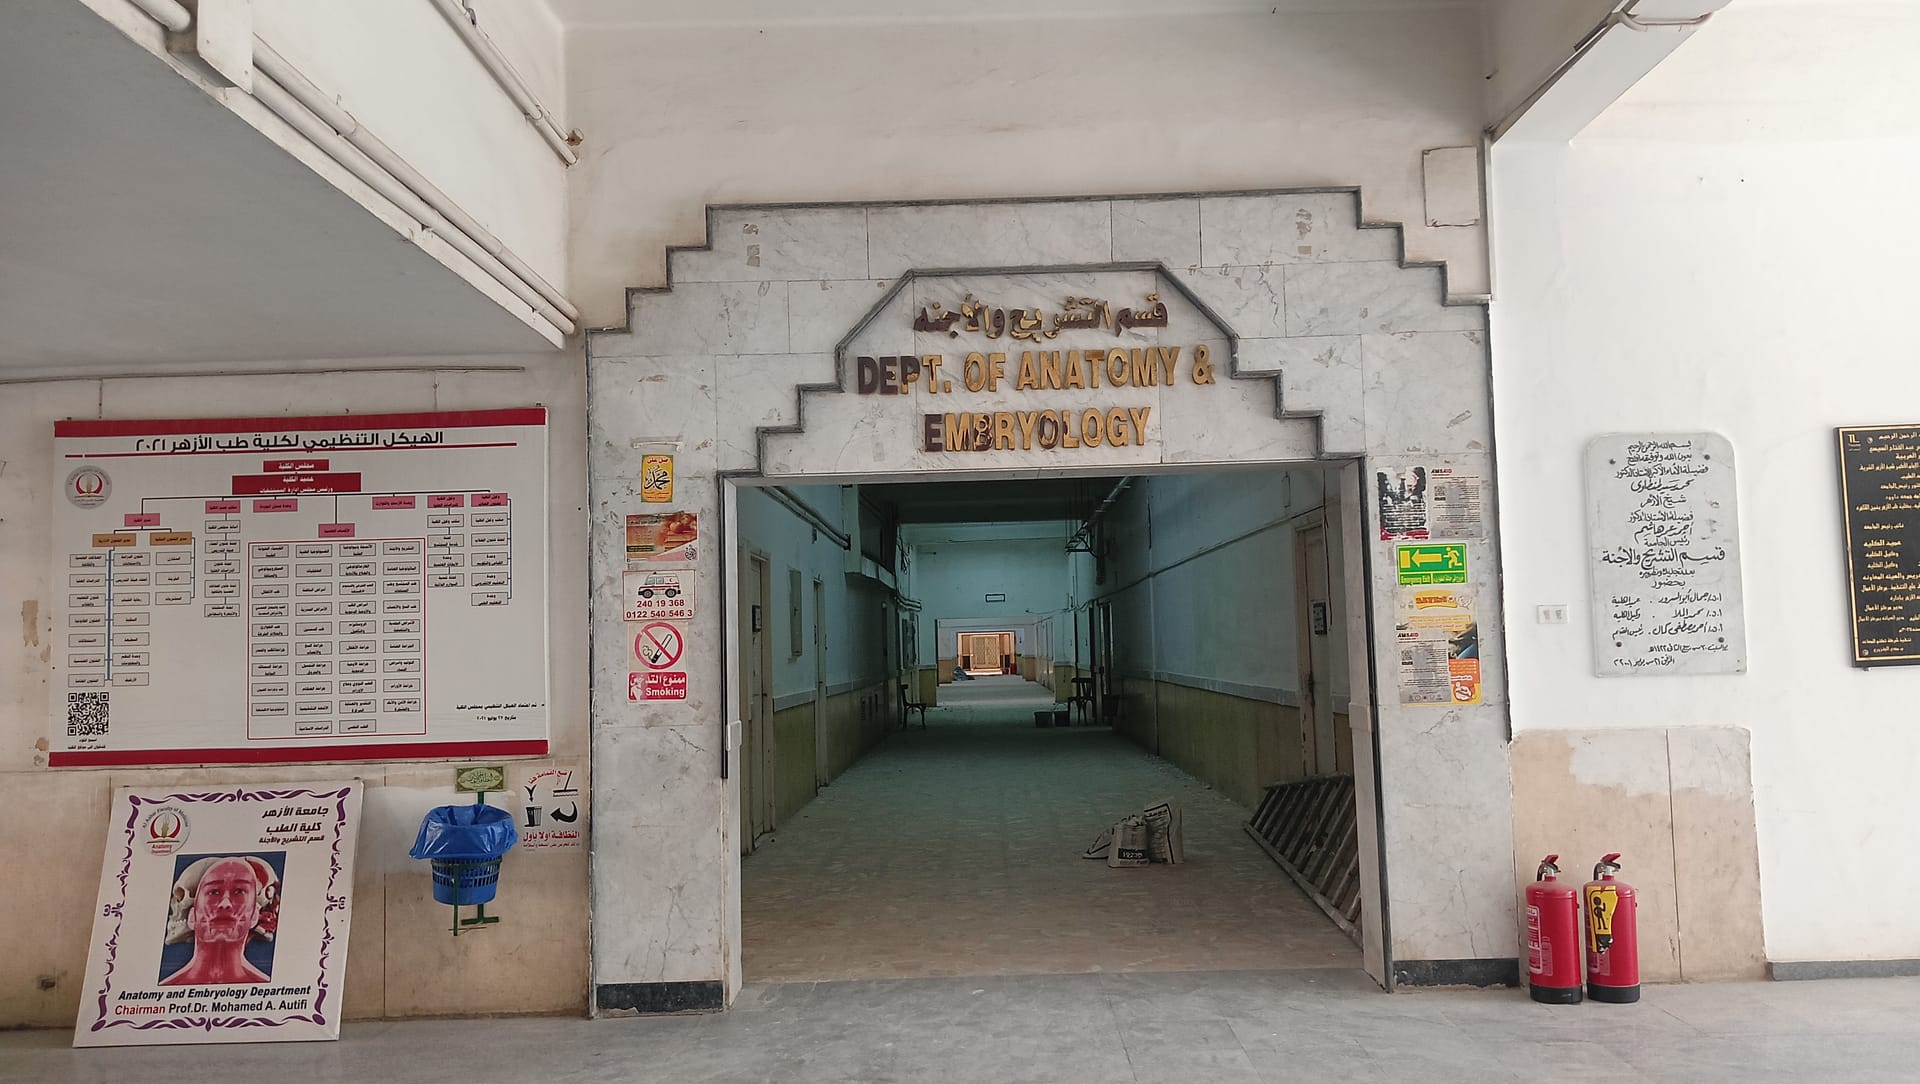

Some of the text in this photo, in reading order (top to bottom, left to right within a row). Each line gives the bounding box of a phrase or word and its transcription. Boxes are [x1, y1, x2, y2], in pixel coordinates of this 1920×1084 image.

[1009, 296, 1112, 343] التشريح
[1115, 293, 1168, 337] قسم
[857, 343, 1216, 395] DEPT. OF ANATOMY &
[924, 406, 1151, 453] EMBRYOLOGY
[136, 431, 444, 454] الهيكل التنظيمي لكلية طب الأزهر ٢٠٢١
[1663, 493, 1687, 508] شيخ
[1641, 546, 1678, 570] التشريح
[1679, 546, 1725, 569] قسم
[1650, 578, 1686, 590] بحضور
[669, 599, 685, 607] 368
[626, 611, 647, 619] 0122
[650, 610, 666, 618] 540
[687, 609, 693, 617] 3
[663, 674, 685, 686] ممنوع
[645, 687, 685, 698] Smoking
[262, 805, 329, 818] جامعة الأزهر
[266, 821, 323, 835] كلية الطب
[118, 985, 311, 1002] Anatomy and Embryology Department
[114, 999, 308, 1016] Chairman Prof.Dr. Mohamed A. Autifi
